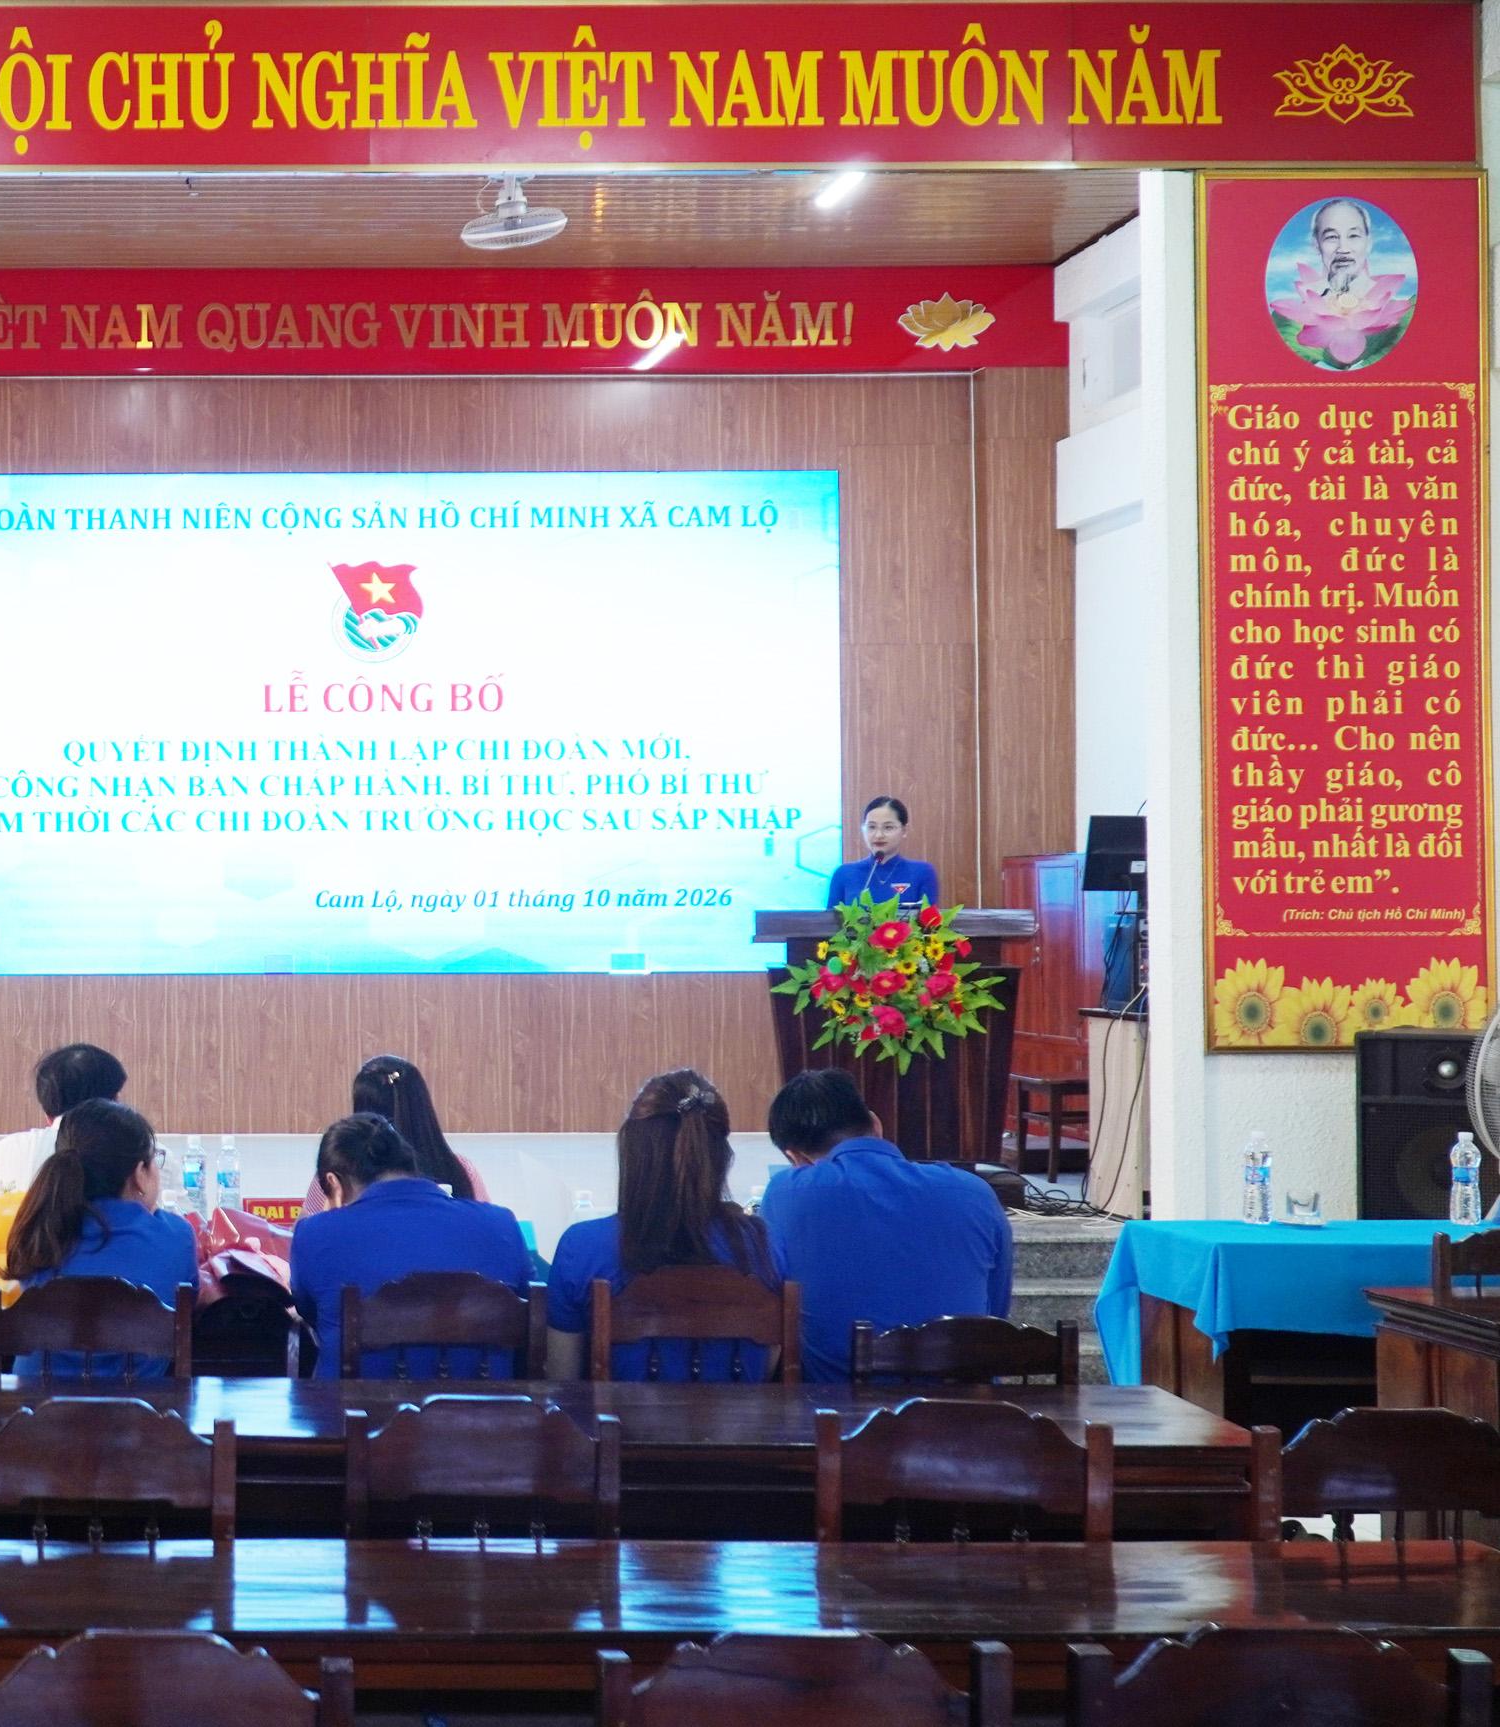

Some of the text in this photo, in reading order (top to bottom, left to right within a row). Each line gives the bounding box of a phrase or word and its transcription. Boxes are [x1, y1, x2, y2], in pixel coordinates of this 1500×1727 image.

[89, 20, 234, 130] CHỦ
[253, 33, 478, 129] NGHĨA
[489, 26, 652, 152] VIỆT
[670, 50, 824, 126] NAM
[840, 24, 1048, 126] MUÔN
[1068, 26, 1221, 124] NĂM
[60, 303, 183, 350] NAM
[197, 302, 381, 353] QUANG
[395, 302, 531, 349] VINH
[541, 288, 703, 352] MUÔN
[715, 290, 854, 349] NĂM!
[1319, 404, 1457, 435] dục phải
[1228, 439, 1457, 472] chú ý cả tài, cả
[1229, 475, 1457, 505] đức, tài là văn
[64, 507, 172, 532] THANH
[182, 501, 252, 530] NIÊN
[261, 501, 342, 536] CỘNG
[351, 500, 408, 529] SẢN
[418, 499, 461, 529] HỒ
[469, 499, 521, 529] CHÍ
[529, 505, 610, 529] MINH
[619, 500, 660, 529] XÃ
[667, 504, 732, 529] CAM
[740, 499, 779, 535] LỘ
[1230, 510, 1458, 542] hóa, chuyên
[1230, 547, 1459, 576] môn, đức là
[1230, 575, 1458, 614] chính trị. Muốn
[1230, 618, 1460, 650] cho học sinh có
[1231, 654, 1460, 685] đức thì giáo
[264, 668, 504, 713] LỄ CÔNG BỐ
[1232, 690, 1460, 721] viên phải có
[179, 738, 258, 769] ĐỊNH
[455, 738, 511, 762] CHI
[521, 733, 610, 762] ĐOÀN
[1335, 726, 1394, 750] Cho
[1410, 725, 1460, 750] nên
[187, 774, 249, 798] BAN
[461, 767, 490, 798] BÍ
[585, 767, 651, 797] PHÓ
[659, 767, 690, 795] BÍ
[1232, 755, 1461, 793] thầy giáo, cô
[30, 804, 111, 834] THỜI
[120, 803, 187, 833] CÁC
[194, 809, 251, 833] CHI
[260, 803, 350, 833] ĐOÀN
[504, 808, 573, 839] HỌC
[581, 808, 641, 832] SAU
[1232, 798, 1463, 831] giáo phải gương
[1234, 826, 1462, 862] mẫu, nhất là đối
[1233, 870, 1277, 894] với
[1284, 869, 1325, 894] trẻ
[315, 887, 733, 913] Cam Lộ, ngày 01 tháng 10 năm 2026
